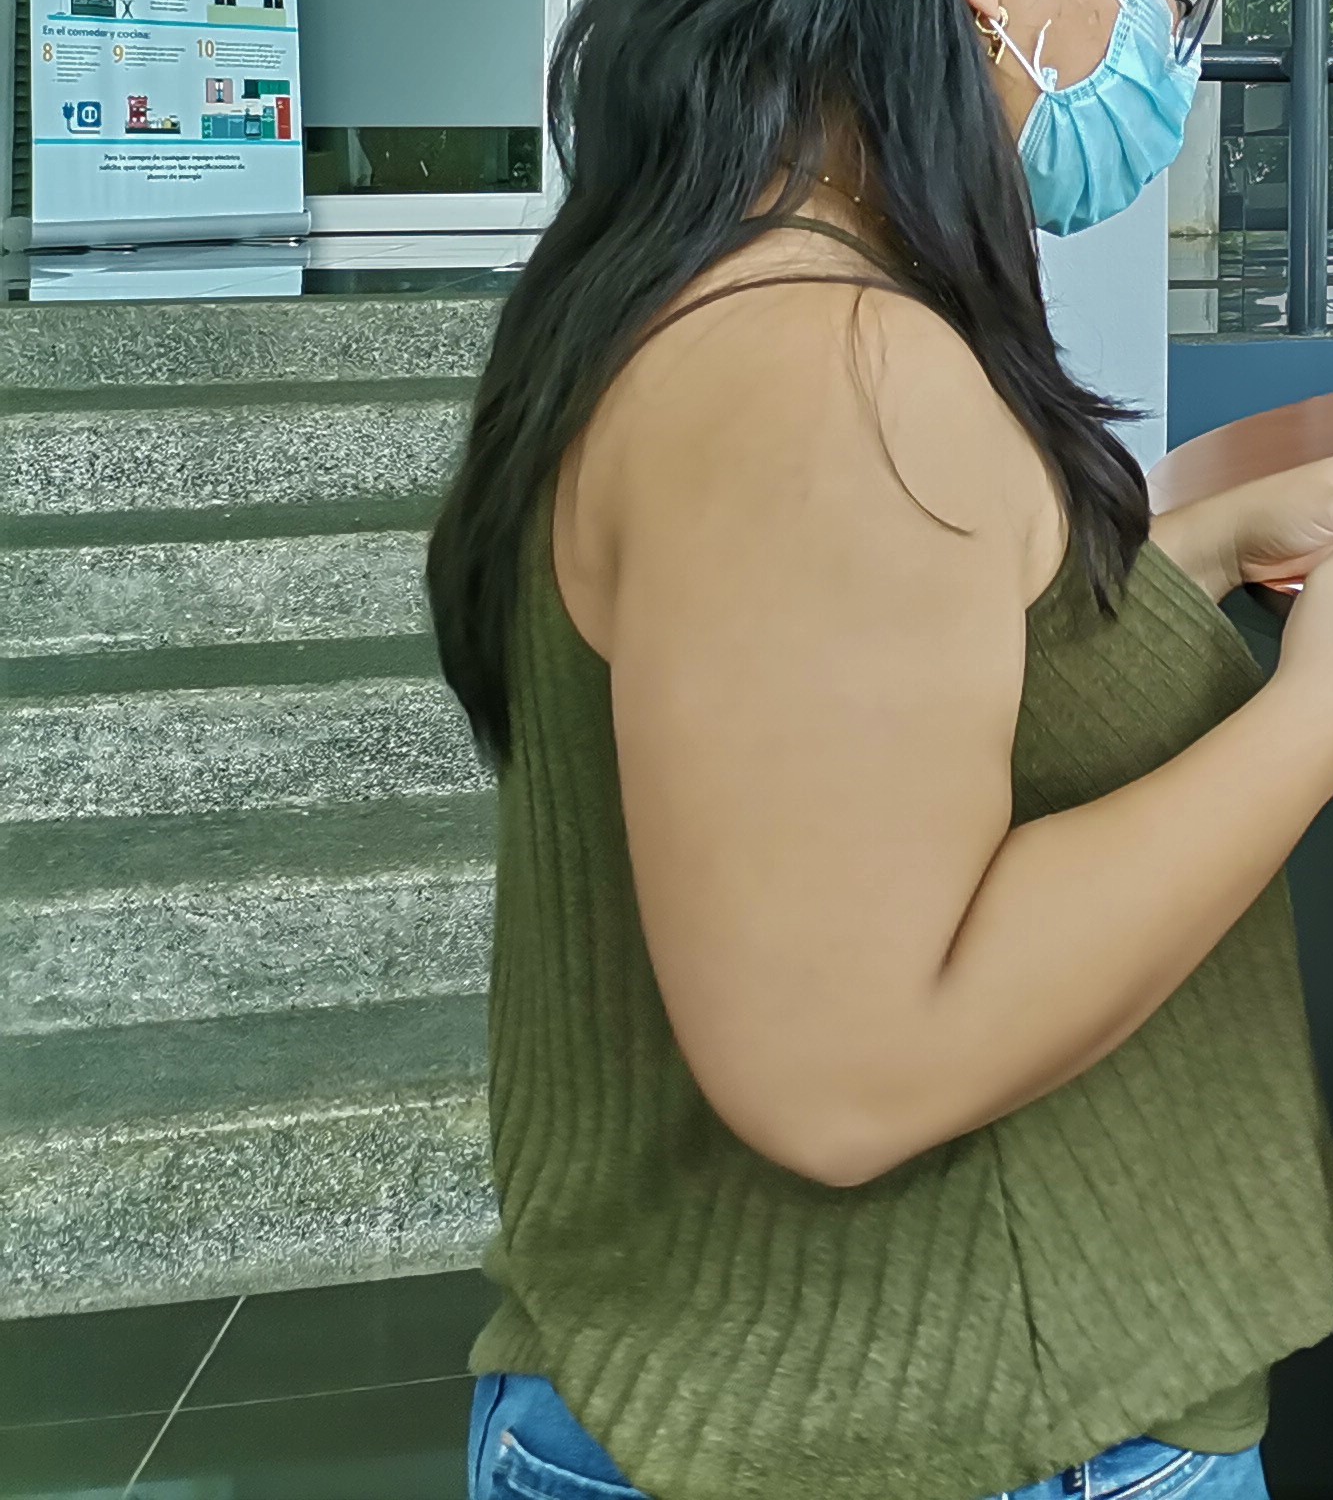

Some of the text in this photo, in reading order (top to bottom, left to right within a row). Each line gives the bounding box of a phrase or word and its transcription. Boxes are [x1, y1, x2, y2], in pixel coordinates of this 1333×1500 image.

[42, 25, 54, 35] En
[56, 26, 66, 36] el
[67, 28, 108, 38] comedor
[109, 31, 116, 40] y
[42, 42, 53, 63] 8
[112, 44, 124, 64] 9
[196, 38, 215, 59] 10
